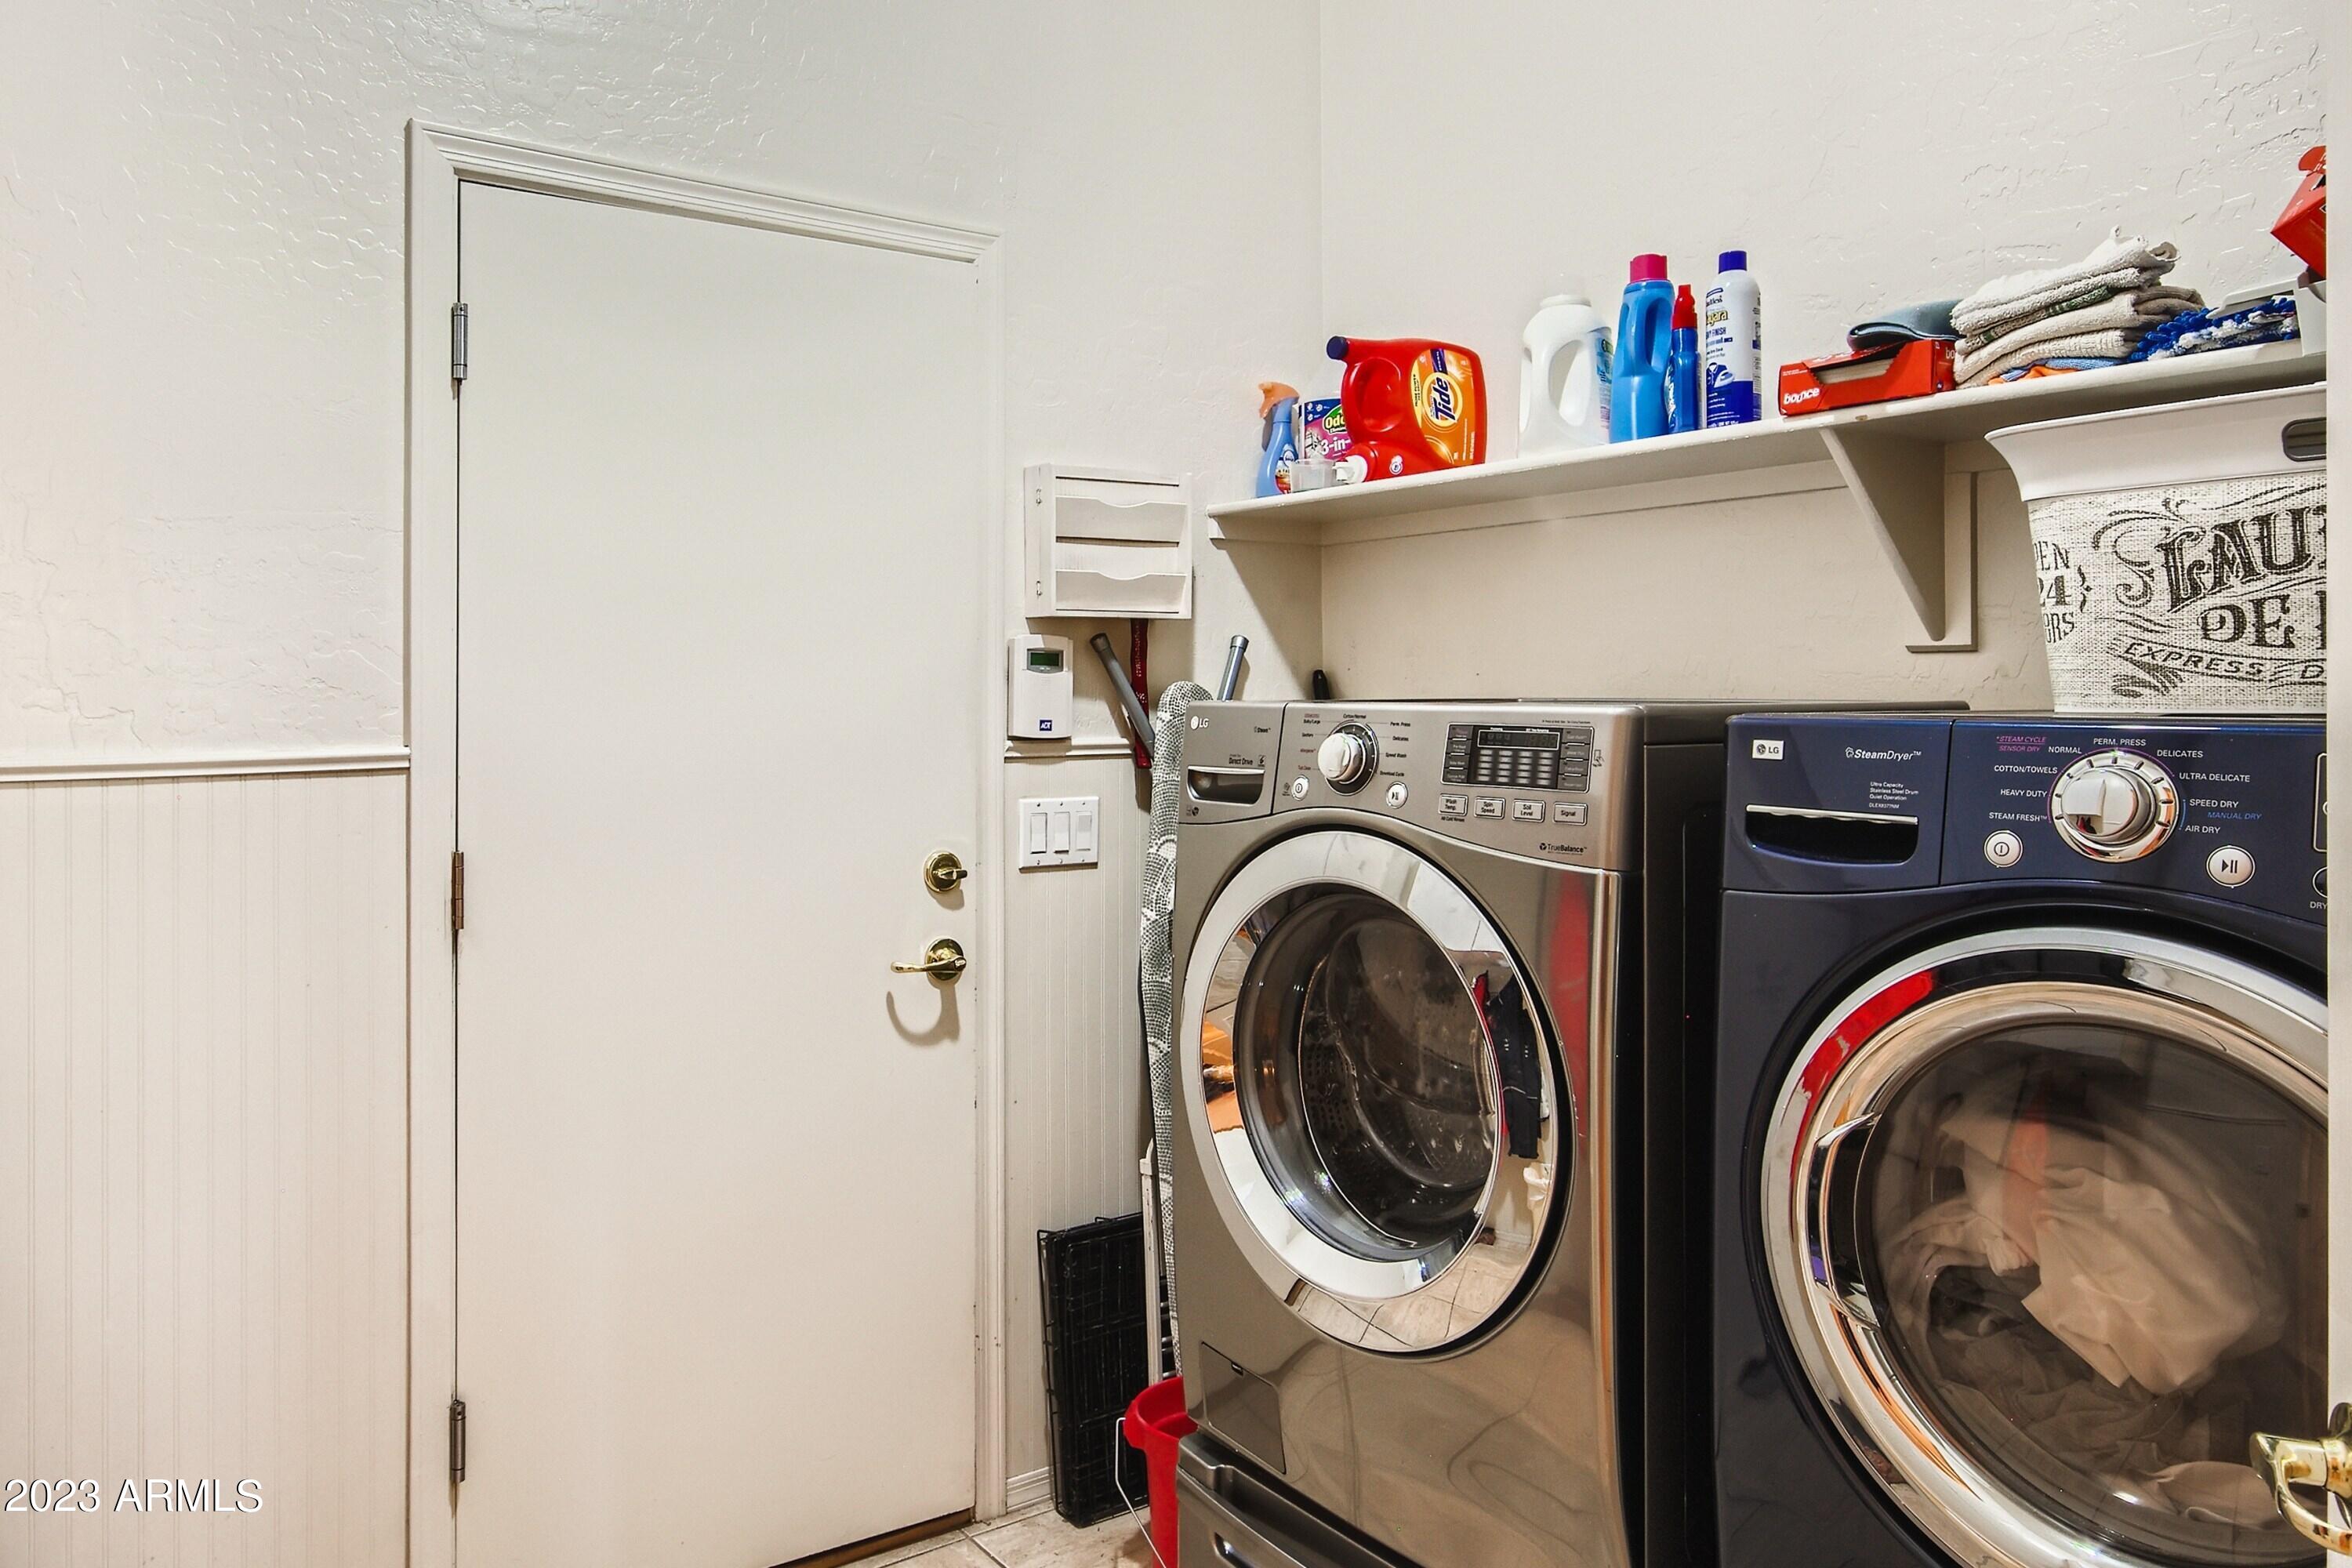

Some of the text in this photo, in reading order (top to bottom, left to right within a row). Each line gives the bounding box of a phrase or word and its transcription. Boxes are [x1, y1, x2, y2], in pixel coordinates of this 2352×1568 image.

[1432, 377, 1456, 421] Tide
[1784, 388, 1820, 405] bounce
[2034, 540, 2070, 571] EN
[2124, 642, 2264, 677] EXPRESS
[1200, 717, 1210, 728] LG
[2048, 746, 2082, 754] NORMAL
[2157, 749, 2204, 759] DELICATES
[1242, 757, 1253, 766] Drive
[1994, 764, 2059, 775] COTTON/TOWELS
[2180, 771, 2251, 783] ULTRA DELICATE
[2000, 788, 2048, 797] HEAVY DUTY
[2189, 798, 2239, 809] SPEED DRY
[1989, 811, 2015, 820] STEAM
[2207, 811, 2263, 821] MANUAL DRY
[2184, 825, 2221, 834] AIR DRY
[2309, 901, 2327, 909] DRY
